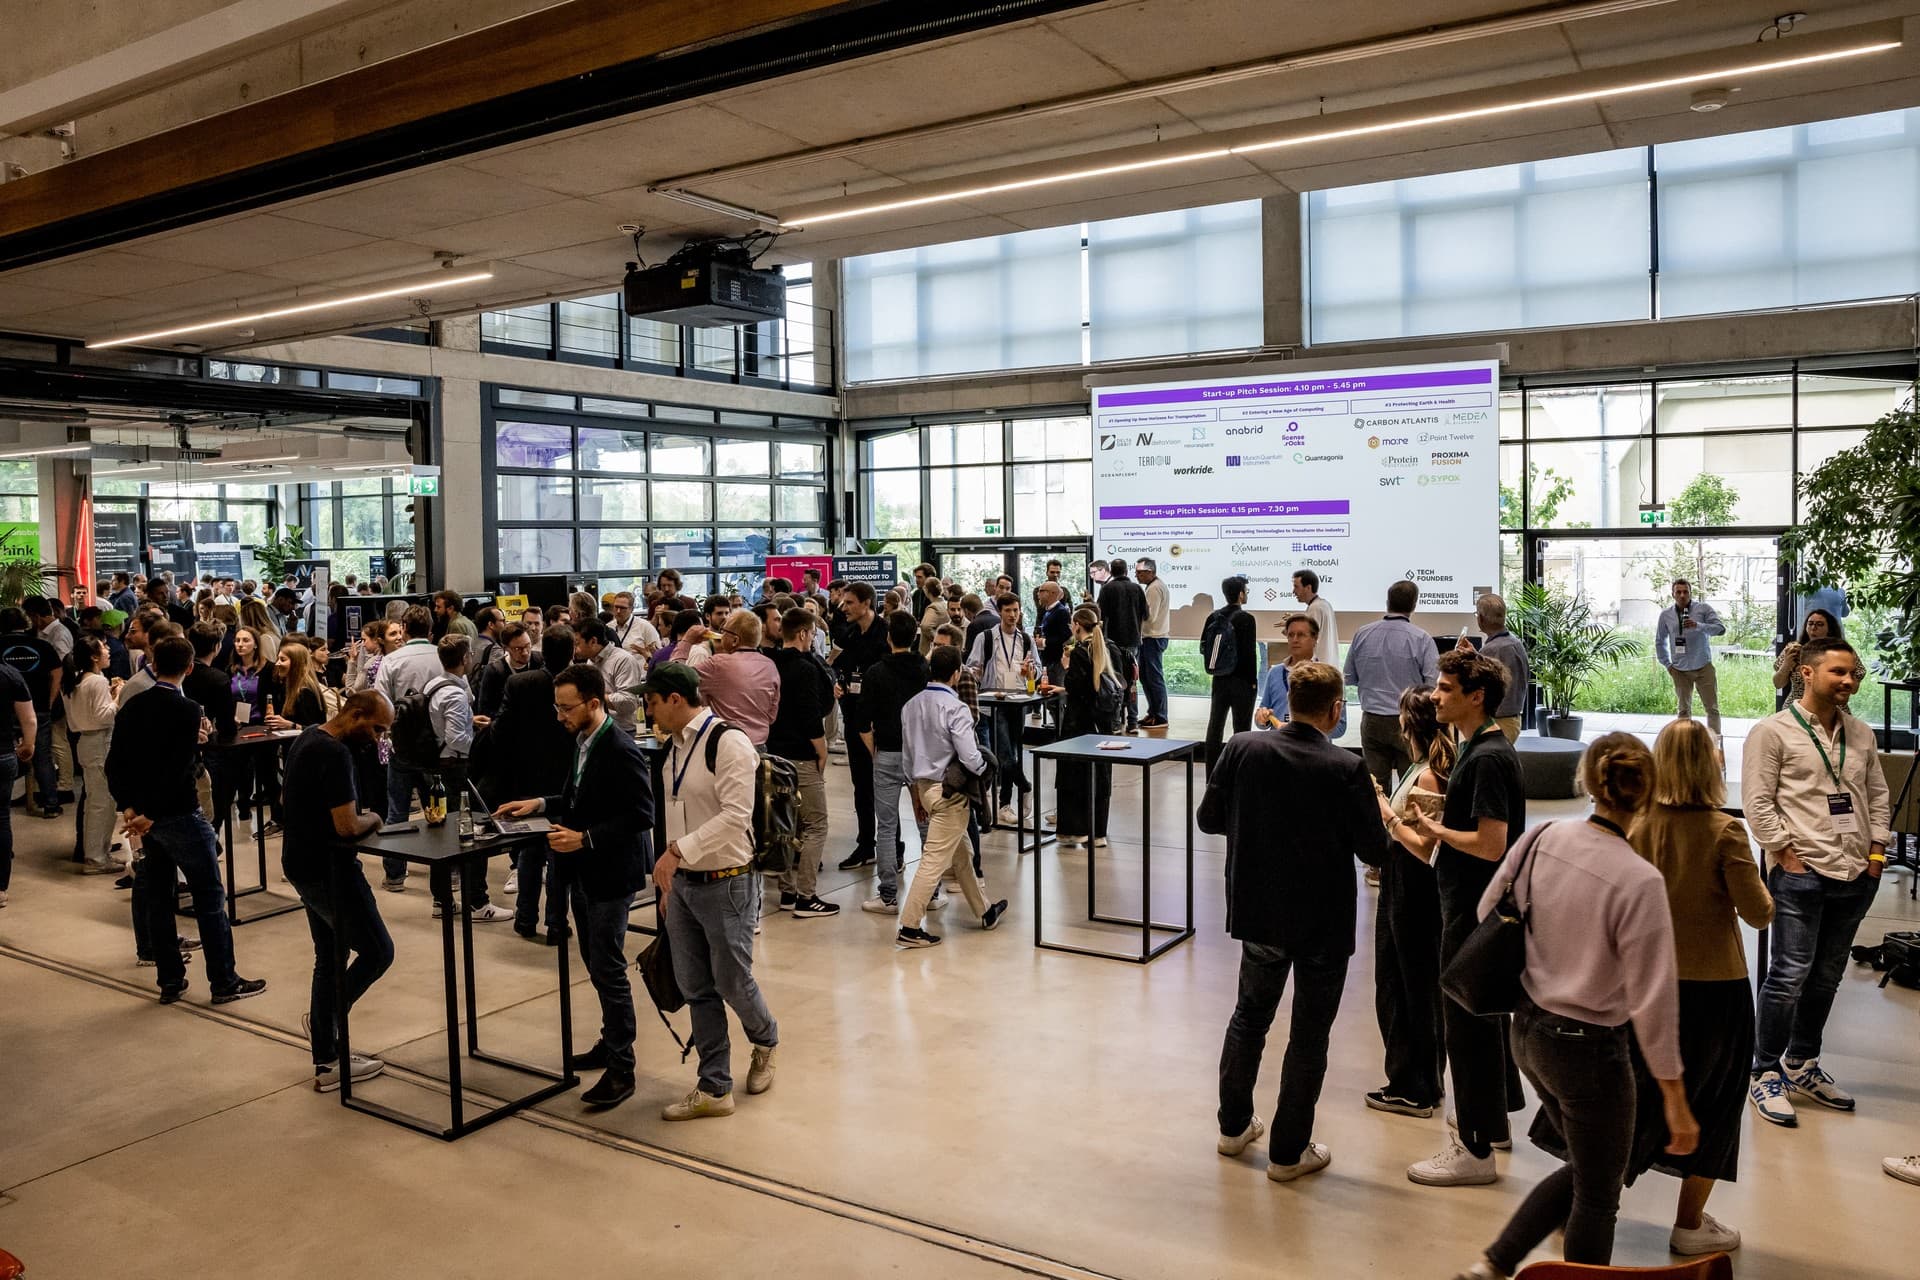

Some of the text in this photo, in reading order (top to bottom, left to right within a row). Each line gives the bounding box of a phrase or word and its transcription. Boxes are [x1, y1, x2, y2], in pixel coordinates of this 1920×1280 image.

[1202, 390, 1236, 398] Start-up
[1259, 386, 1292, 394] Session:
[1352, 382, 1366, 390] pm
[1366, 417, 1439, 427] CARBON ATLANTIS
[1225, 425, 1264, 436] anabrid
[1431, 451, 1470, 459] PROXIMA
[1388, 456, 1418, 464] Protein
[1143, 508, 1175, 516] Start-up
[1198, 506, 1229, 514] Session:
[1247, 506, 1260, 514] pm
[1268, 505, 1285, 513] 7.30
[1286, 506, 1299, 514] pm
[1303, 543, 1332, 552] Lattice
[1306, 558, 1339, 566] RobotAI
[1318, 575, 1333, 583] Viz
